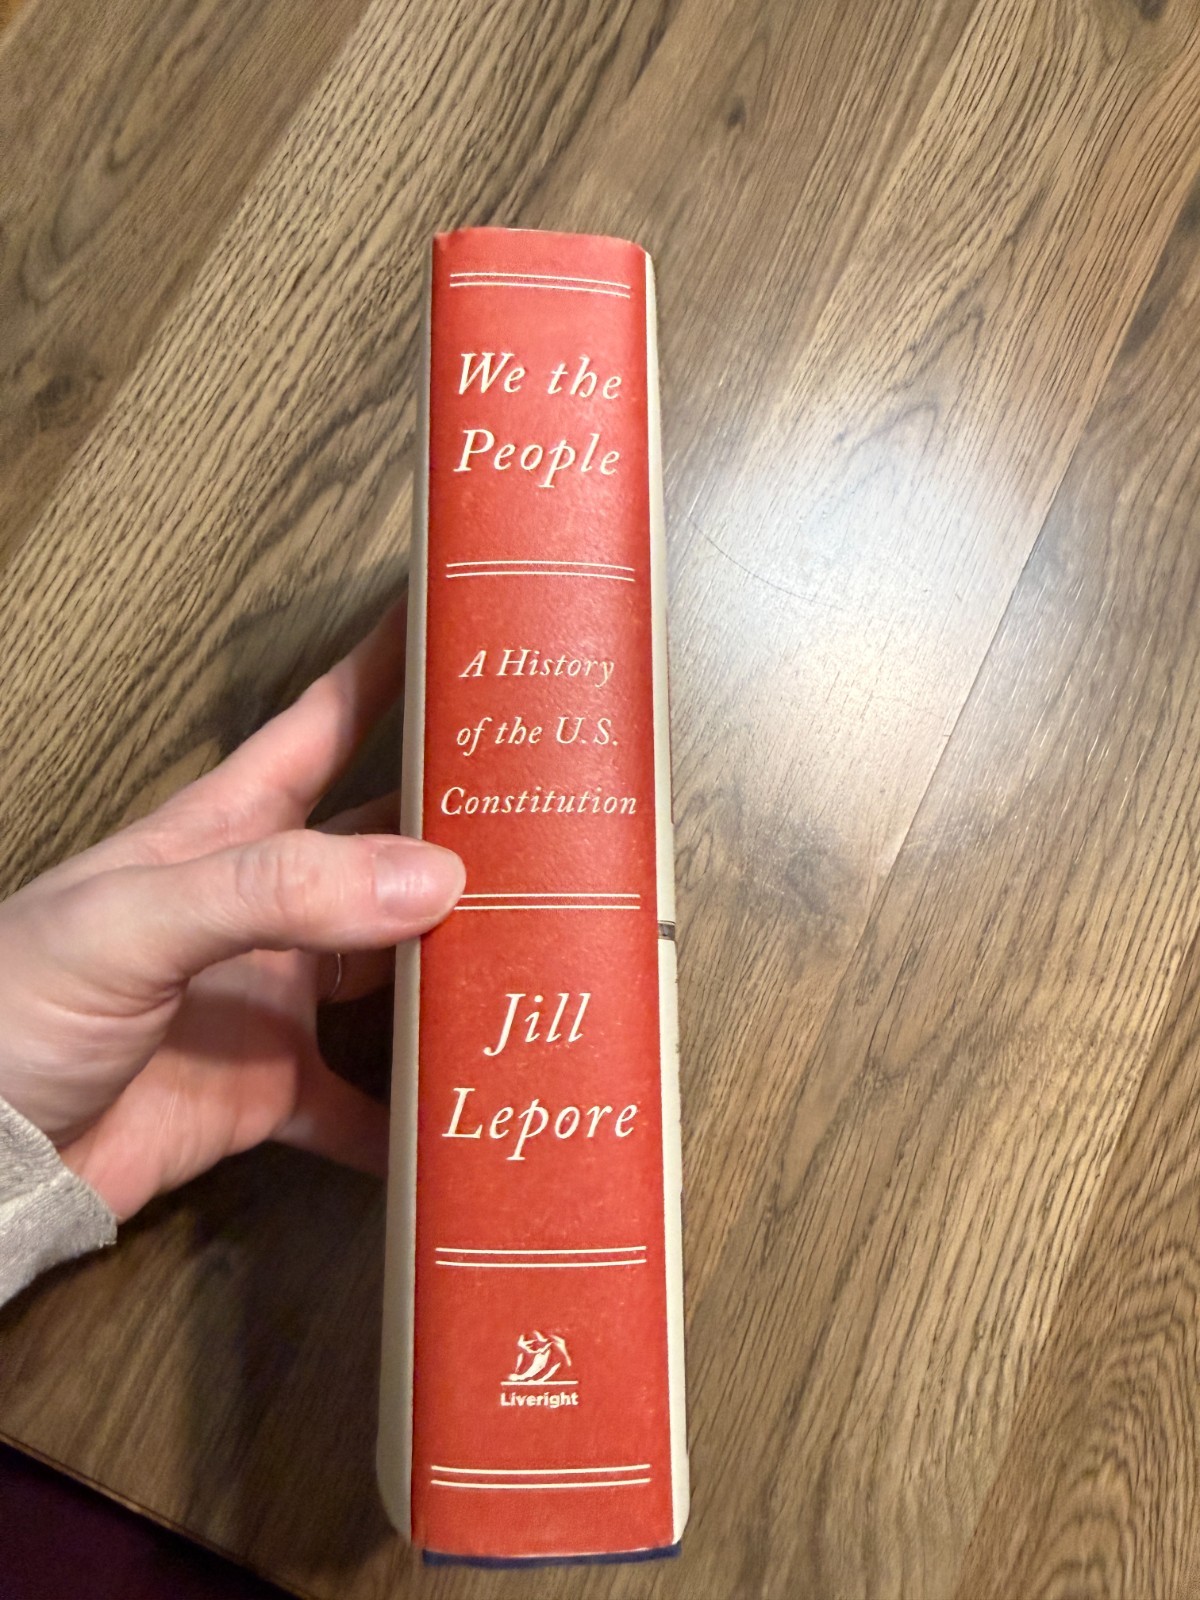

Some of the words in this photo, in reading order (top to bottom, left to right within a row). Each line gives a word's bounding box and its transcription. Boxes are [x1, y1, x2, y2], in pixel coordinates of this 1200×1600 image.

[458, 351, 526, 395] We
[546, 355, 623, 399] the
[453, 429, 622, 489] People
[458, 649, 485, 678] A
[496, 648, 615, 688] History
[456, 716, 493, 756] of
[494, 716, 542, 746] the
[554, 716, 619, 747] U.S.
[440, 786, 638, 816] Constitution
[482, 991, 592, 1058] Jill
[441, 1087, 640, 1162] Lepore
[500, 1391, 580, 1409] Liveright
